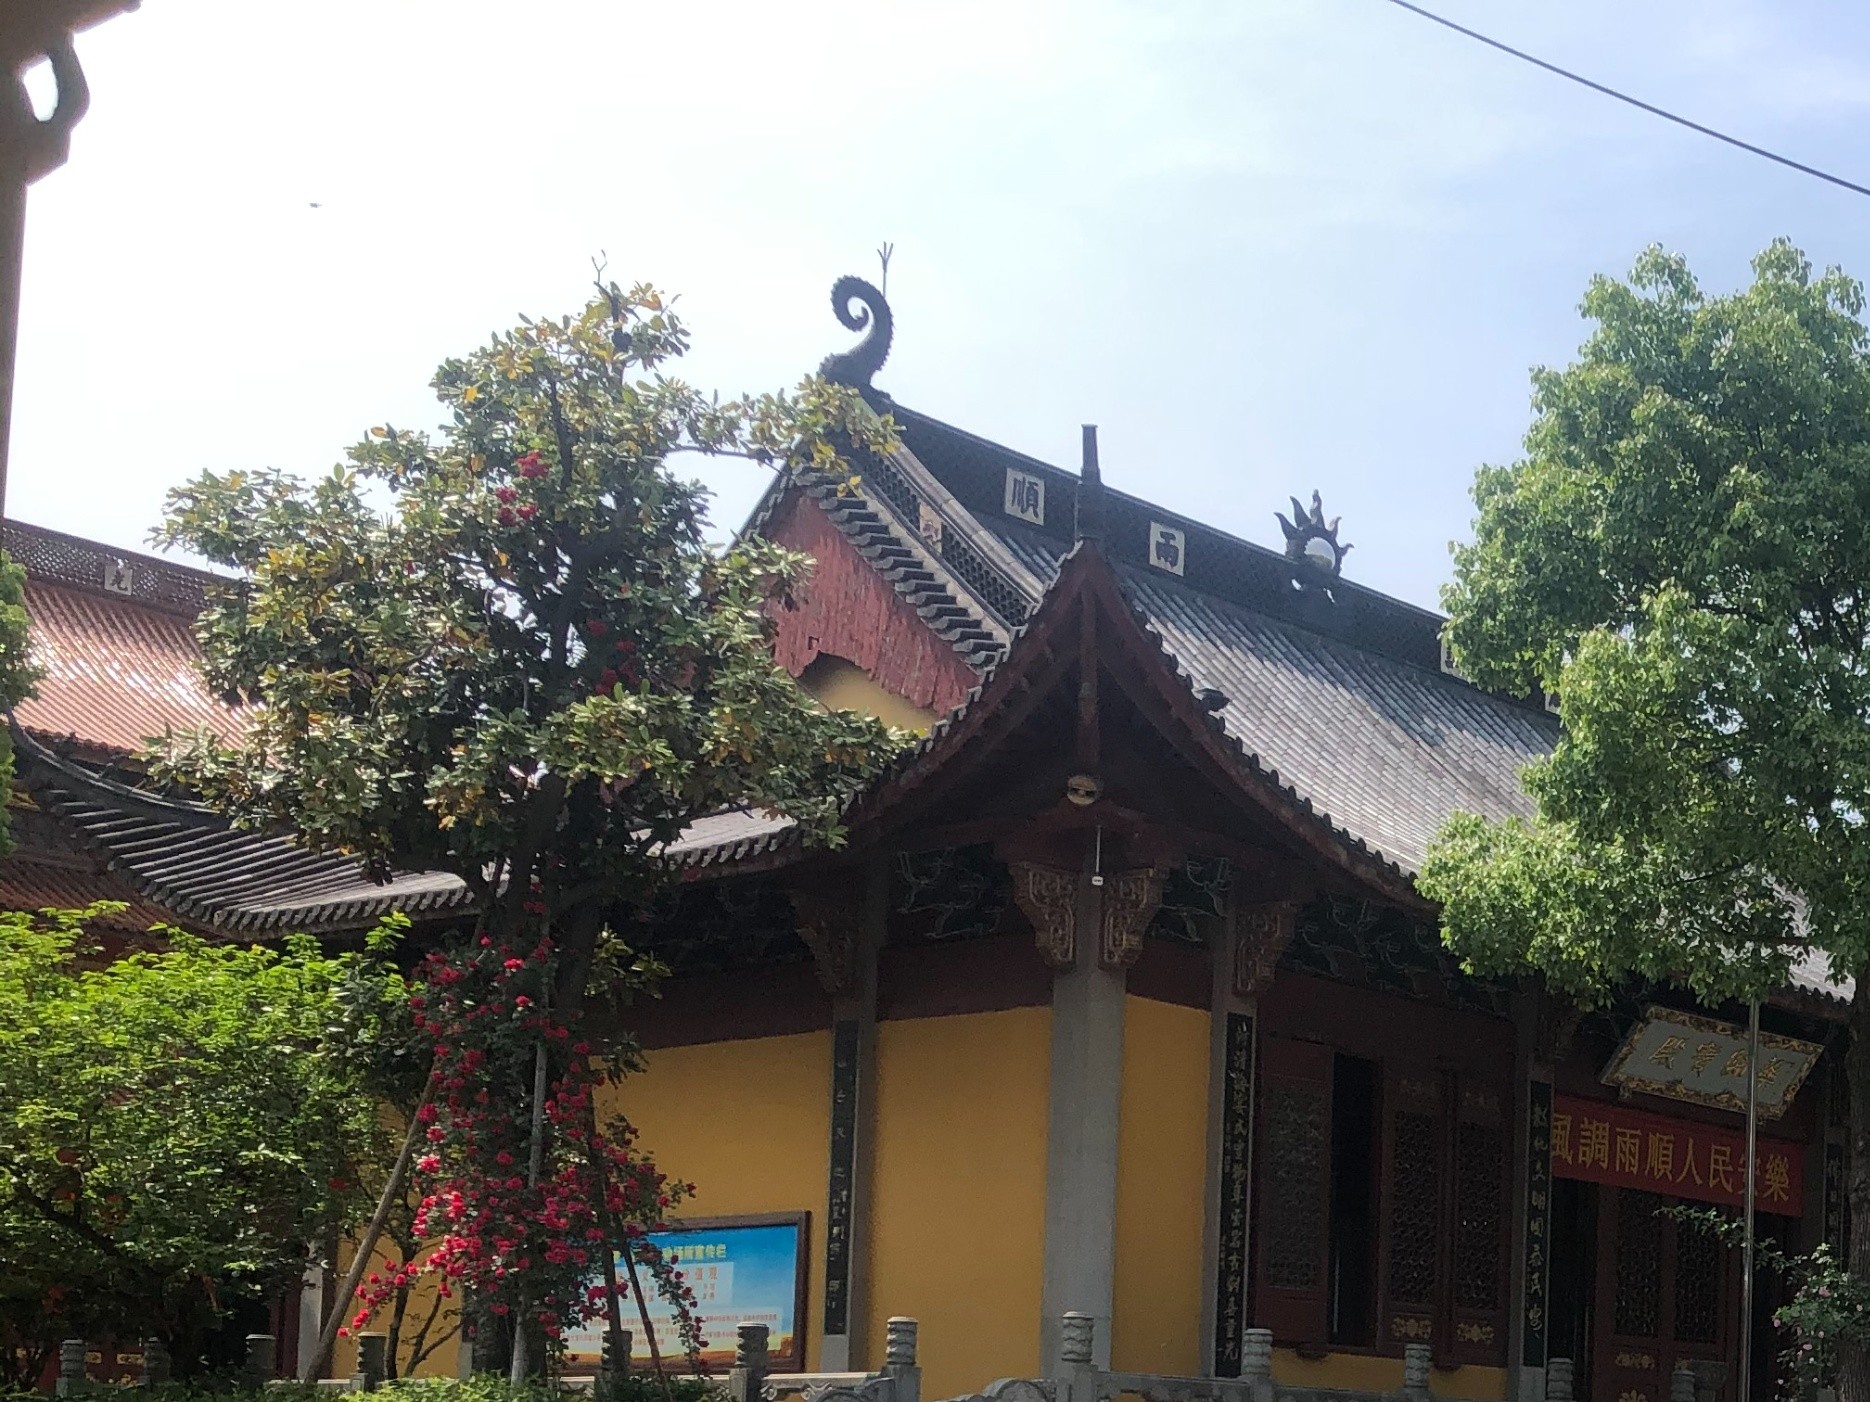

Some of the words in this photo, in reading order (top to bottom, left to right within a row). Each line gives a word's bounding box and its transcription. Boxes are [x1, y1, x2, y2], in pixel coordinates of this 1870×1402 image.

[1012, 476, 1040, 518] 順
[1551, 1112, 1790, 1202] 風調雨順人民安樂
